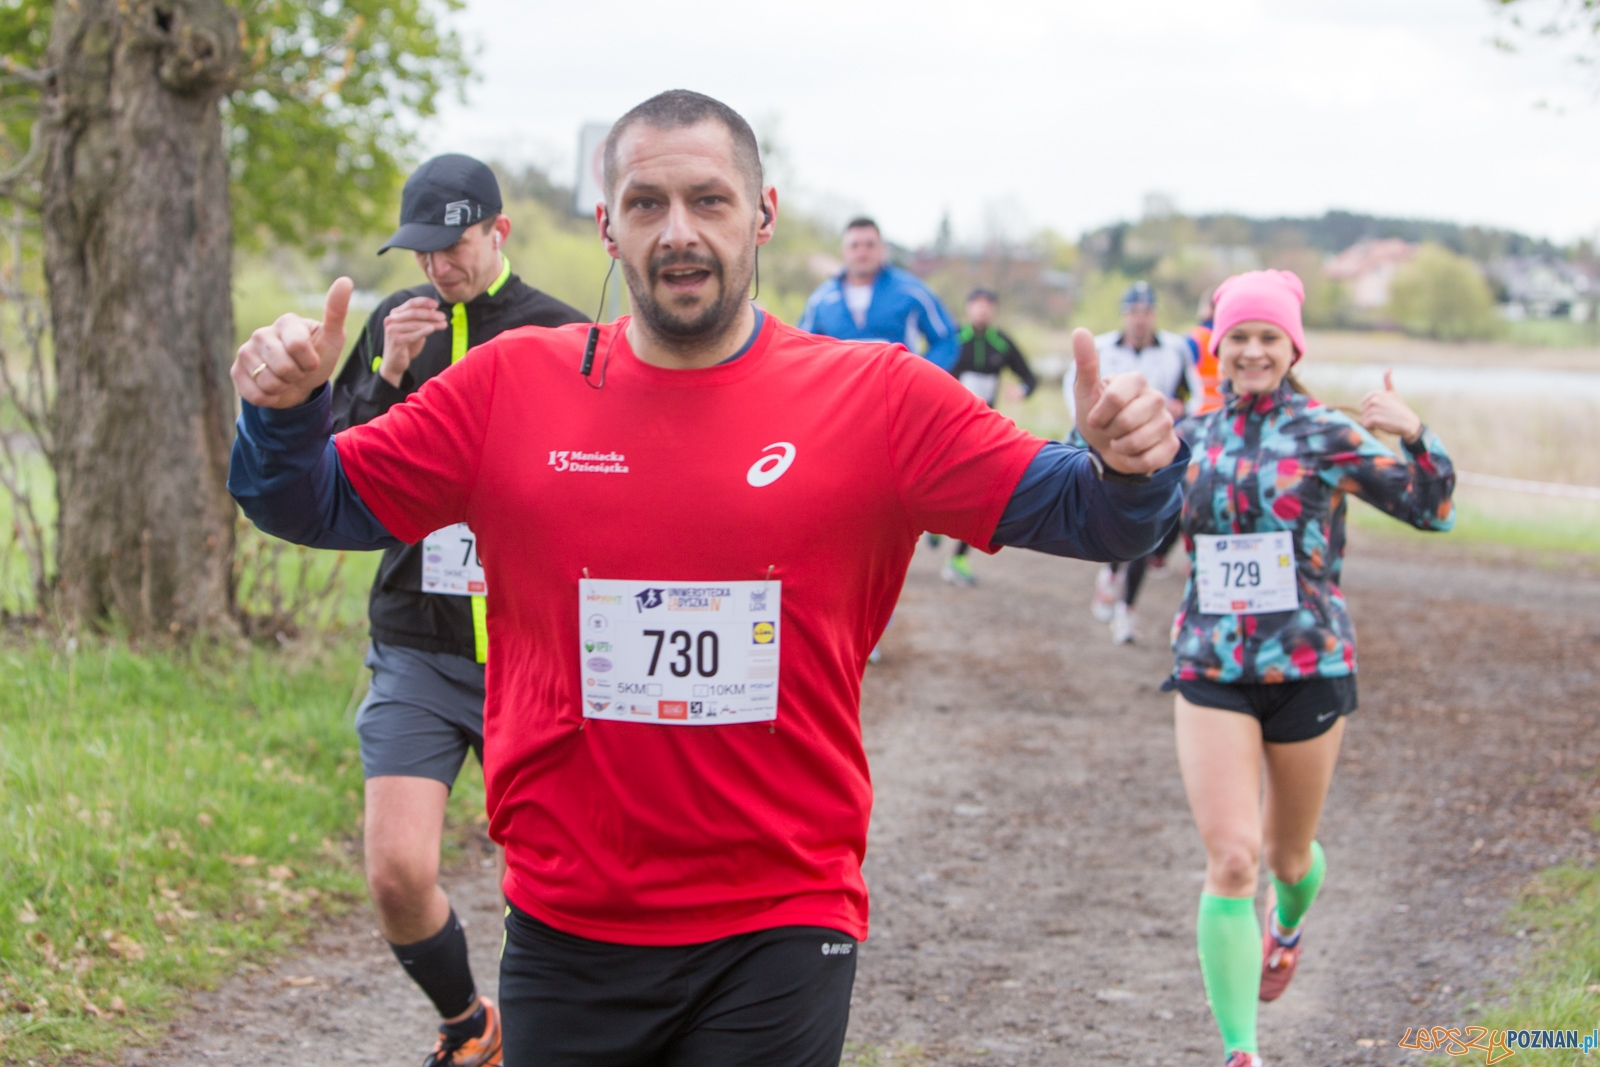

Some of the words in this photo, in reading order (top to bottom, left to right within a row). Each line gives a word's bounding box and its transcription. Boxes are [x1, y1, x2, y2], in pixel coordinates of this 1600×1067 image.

[547, 450, 570, 473] 13
[570, 451, 625, 462] Maniacka
[569, 462, 629, 474] Dziesiątka
[1220, 561, 1261, 588] 729
[667, 588, 731, 597] UNIWERSYTECKA
[642, 629, 720, 678] 730
[617, 682, 646, 694] 5KM
[709, 684, 745, 695] 10KM
